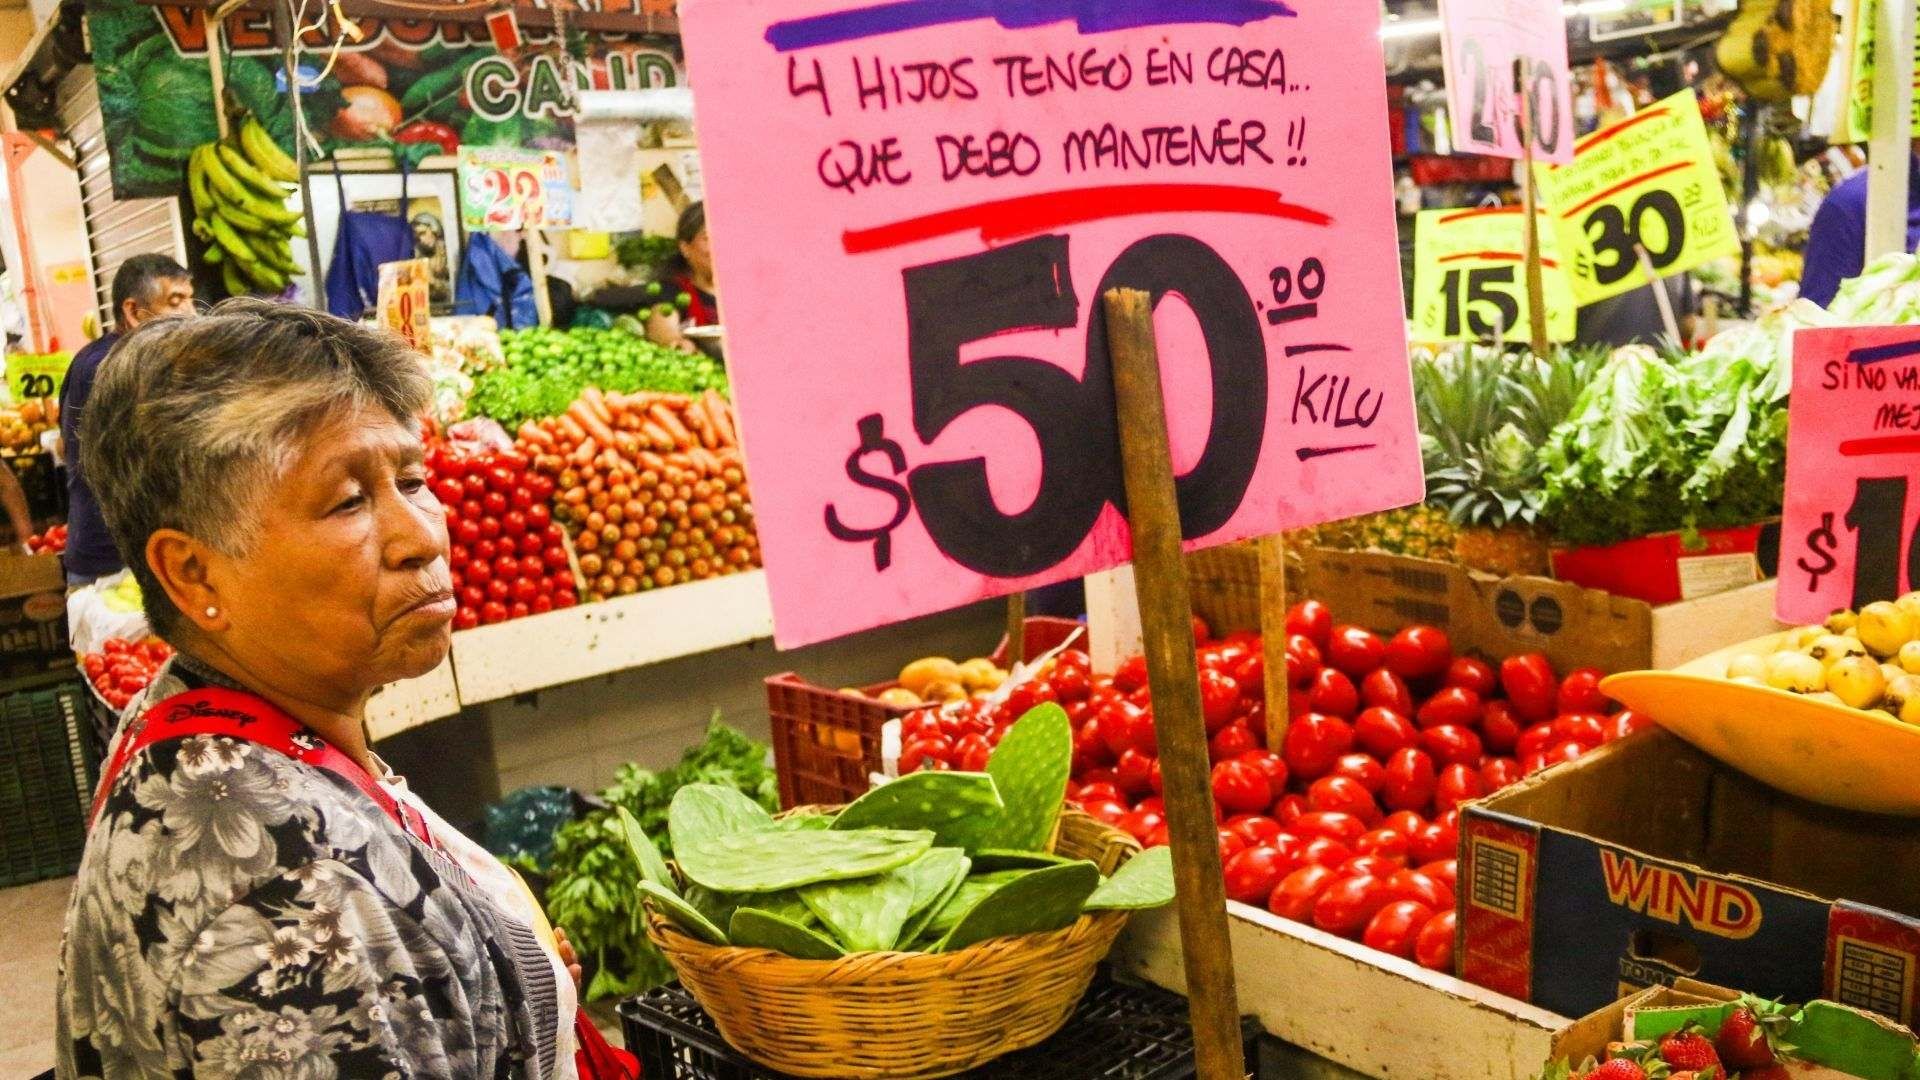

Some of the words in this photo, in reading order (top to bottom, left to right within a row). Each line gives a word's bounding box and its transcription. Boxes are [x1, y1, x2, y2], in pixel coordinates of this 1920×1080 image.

[788, 55, 831, 117] 4
[852, 56, 979, 111] HIJOS
[993, 48, 1132, 97] TENGO
[1147, 48, 1193, 86] EN
[817, 136, 912, 194] QUE
[935, 129, 1041, 182] DEBO
[1063, 118, 1275, 174] MANTENER
[20, 373, 55, 399] 20
[1856, 362, 1887, 391] NO
[1892, 366, 1920, 391] VA
[164, 699, 259, 728] Disney
[1600, 846, 1763, 940] WIND
